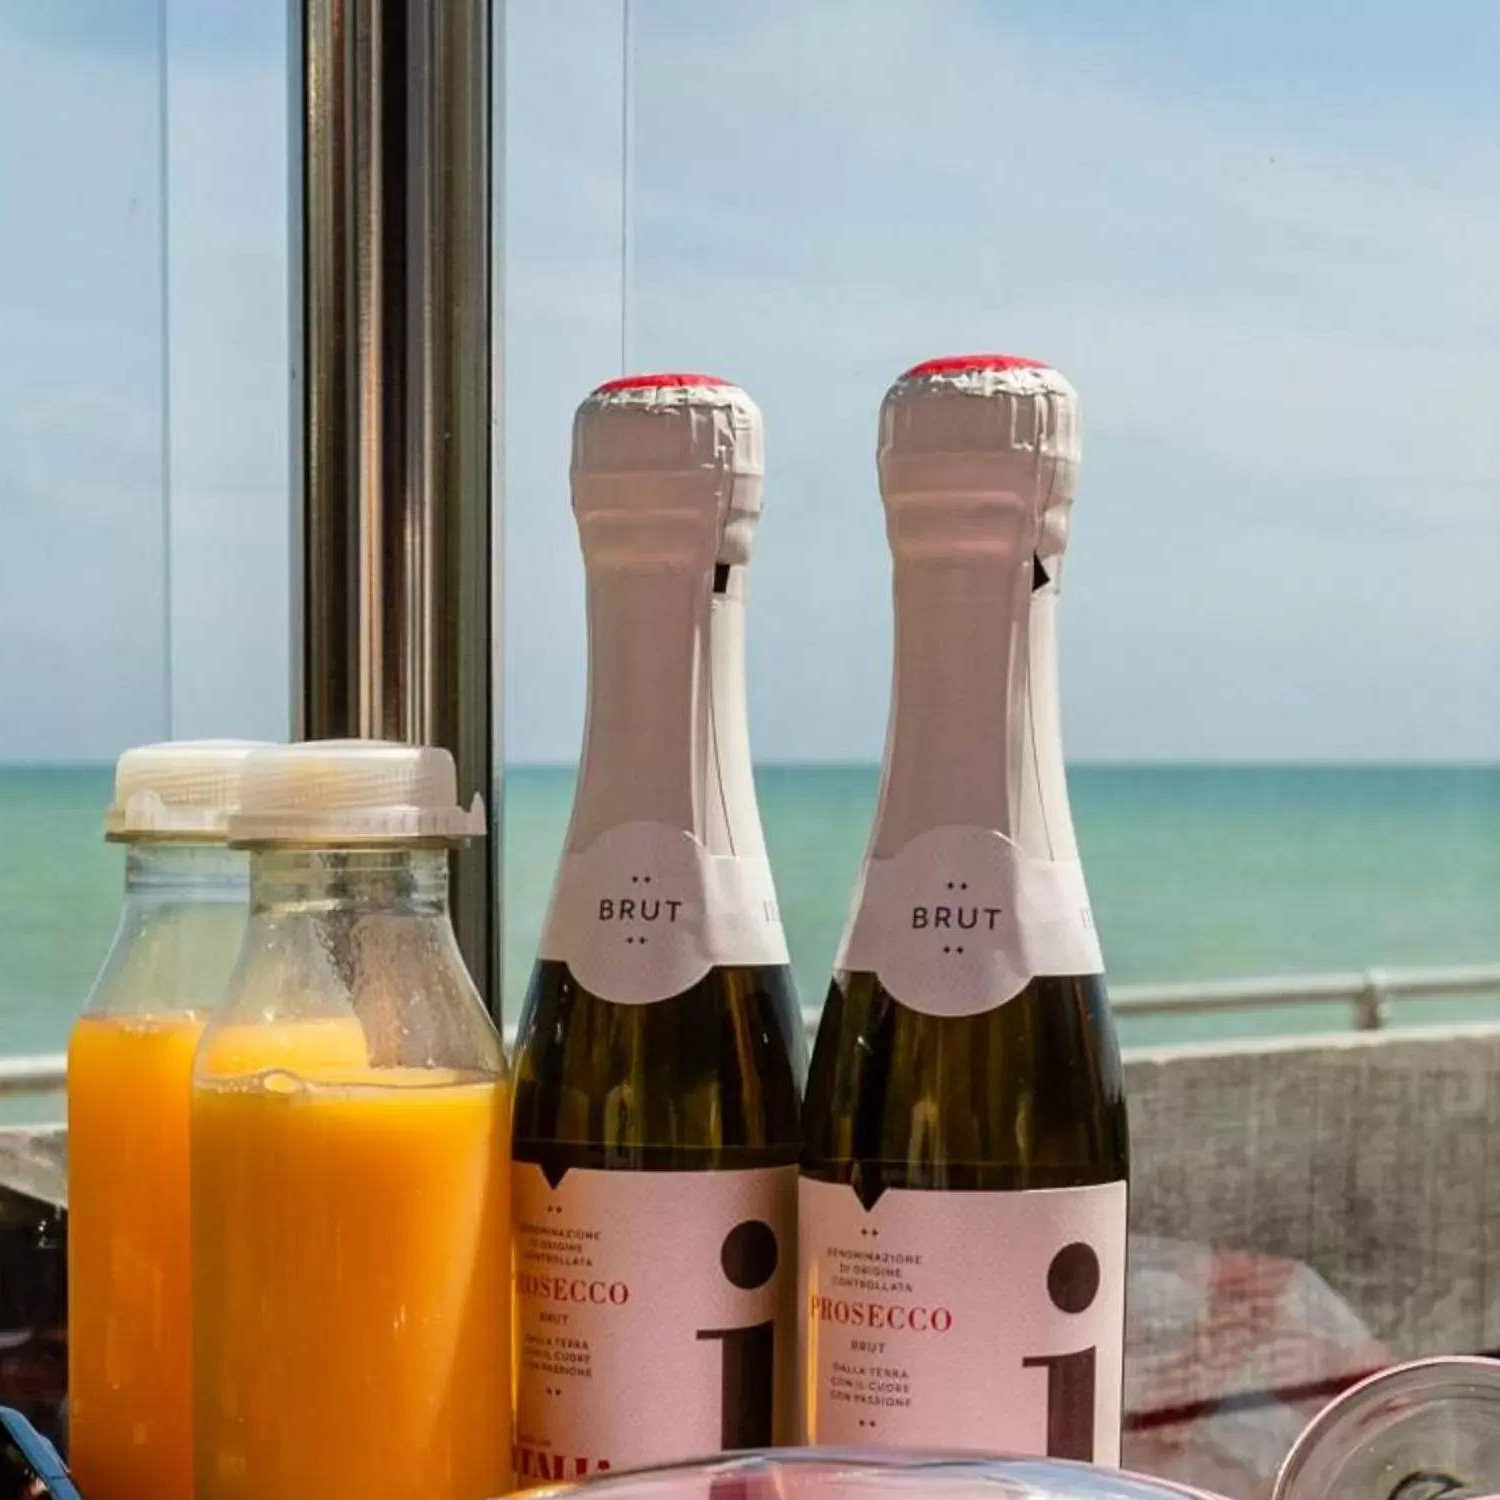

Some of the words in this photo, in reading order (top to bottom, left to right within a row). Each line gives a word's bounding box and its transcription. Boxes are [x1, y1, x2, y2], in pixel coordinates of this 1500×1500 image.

[599, 898, 682, 922] BRUT
[912, 905, 1003, 930] BRUT
[520, 1225, 602, 1241] MINAZIONE
[523, 1250, 593, 1267] TROLLATA
[827, 1247, 922, 1265] DENOMINAZIONE
[853, 1264, 901, 1278] ORIGINE
[516, 1271, 629, 1305] ROSECCO
[832, 1276, 913, 1292] CONTROLLATA
[810, 1296, 952, 1332] PROSECCO
[851, 1339, 884, 1353] BRUT
[832, 1362, 864, 1375] DALLA
[870, 1367, 908, 1379] TERRA
[868, 1381, 909, 1394] CUORE
[853, 1393, 911, 1407] PASSIONE
